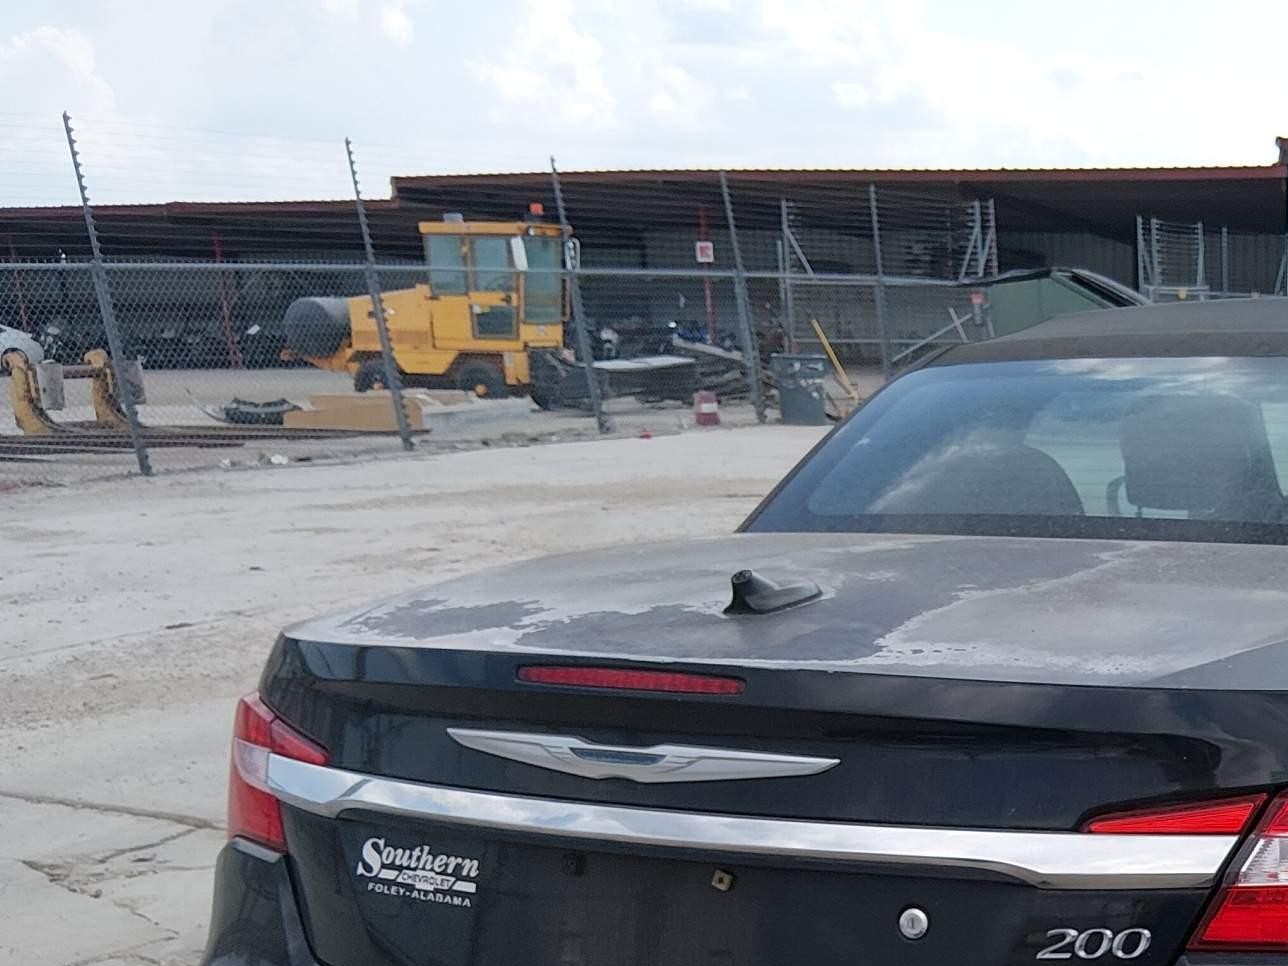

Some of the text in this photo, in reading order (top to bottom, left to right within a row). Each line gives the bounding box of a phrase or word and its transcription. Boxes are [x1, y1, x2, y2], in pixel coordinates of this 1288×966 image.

[357, 838, 479, 877] Southern
[401, 871, 452, 888] CHEVROLET
[1036, 928, 1151, 959] 200
